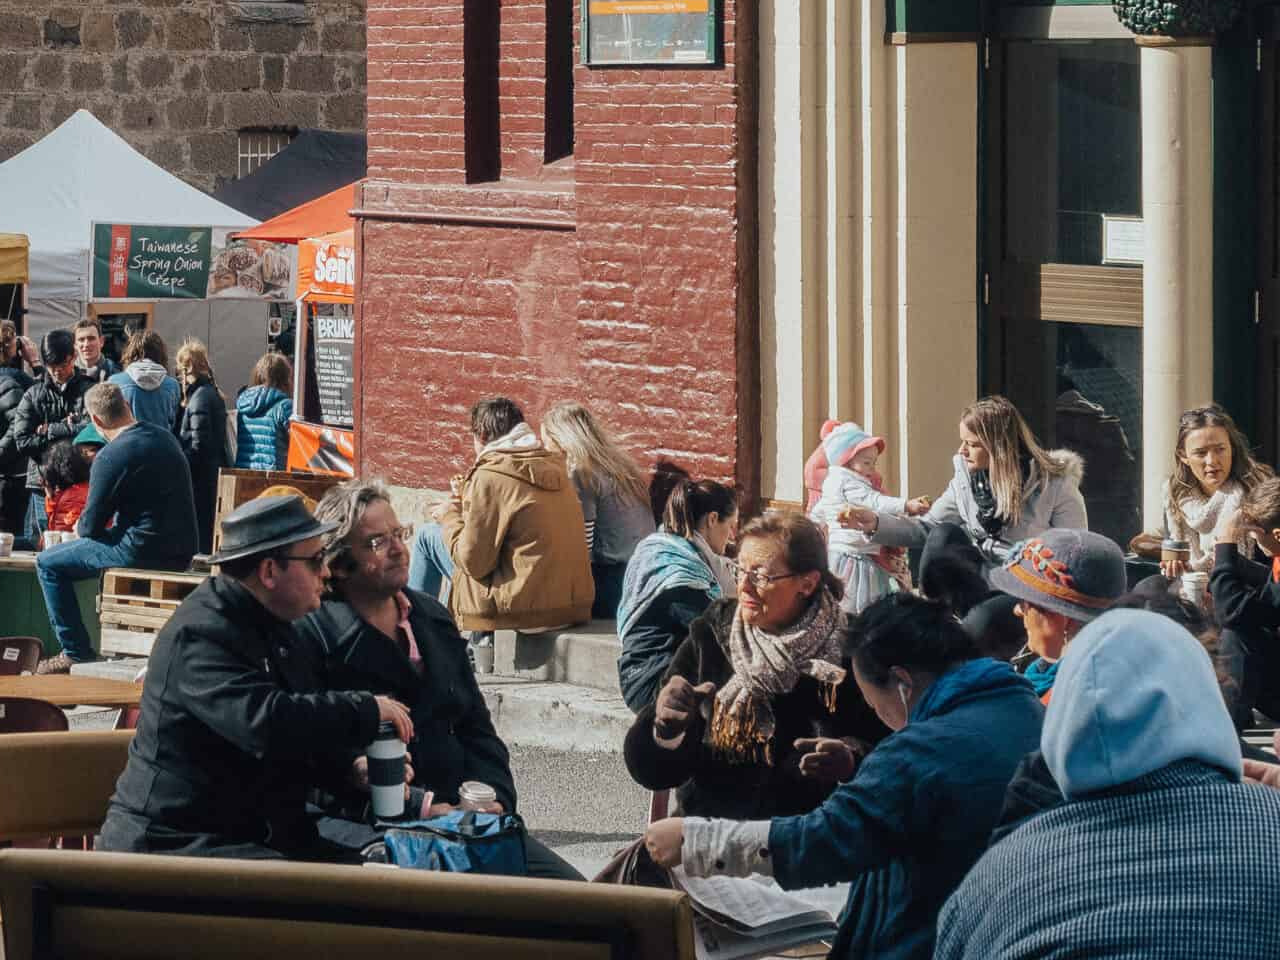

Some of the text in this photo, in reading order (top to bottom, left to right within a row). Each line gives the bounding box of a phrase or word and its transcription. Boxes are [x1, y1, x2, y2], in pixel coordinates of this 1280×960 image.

[138, 237, 199, 254] Taiwanese
[129, 254, 202, 280] Spring Onion
